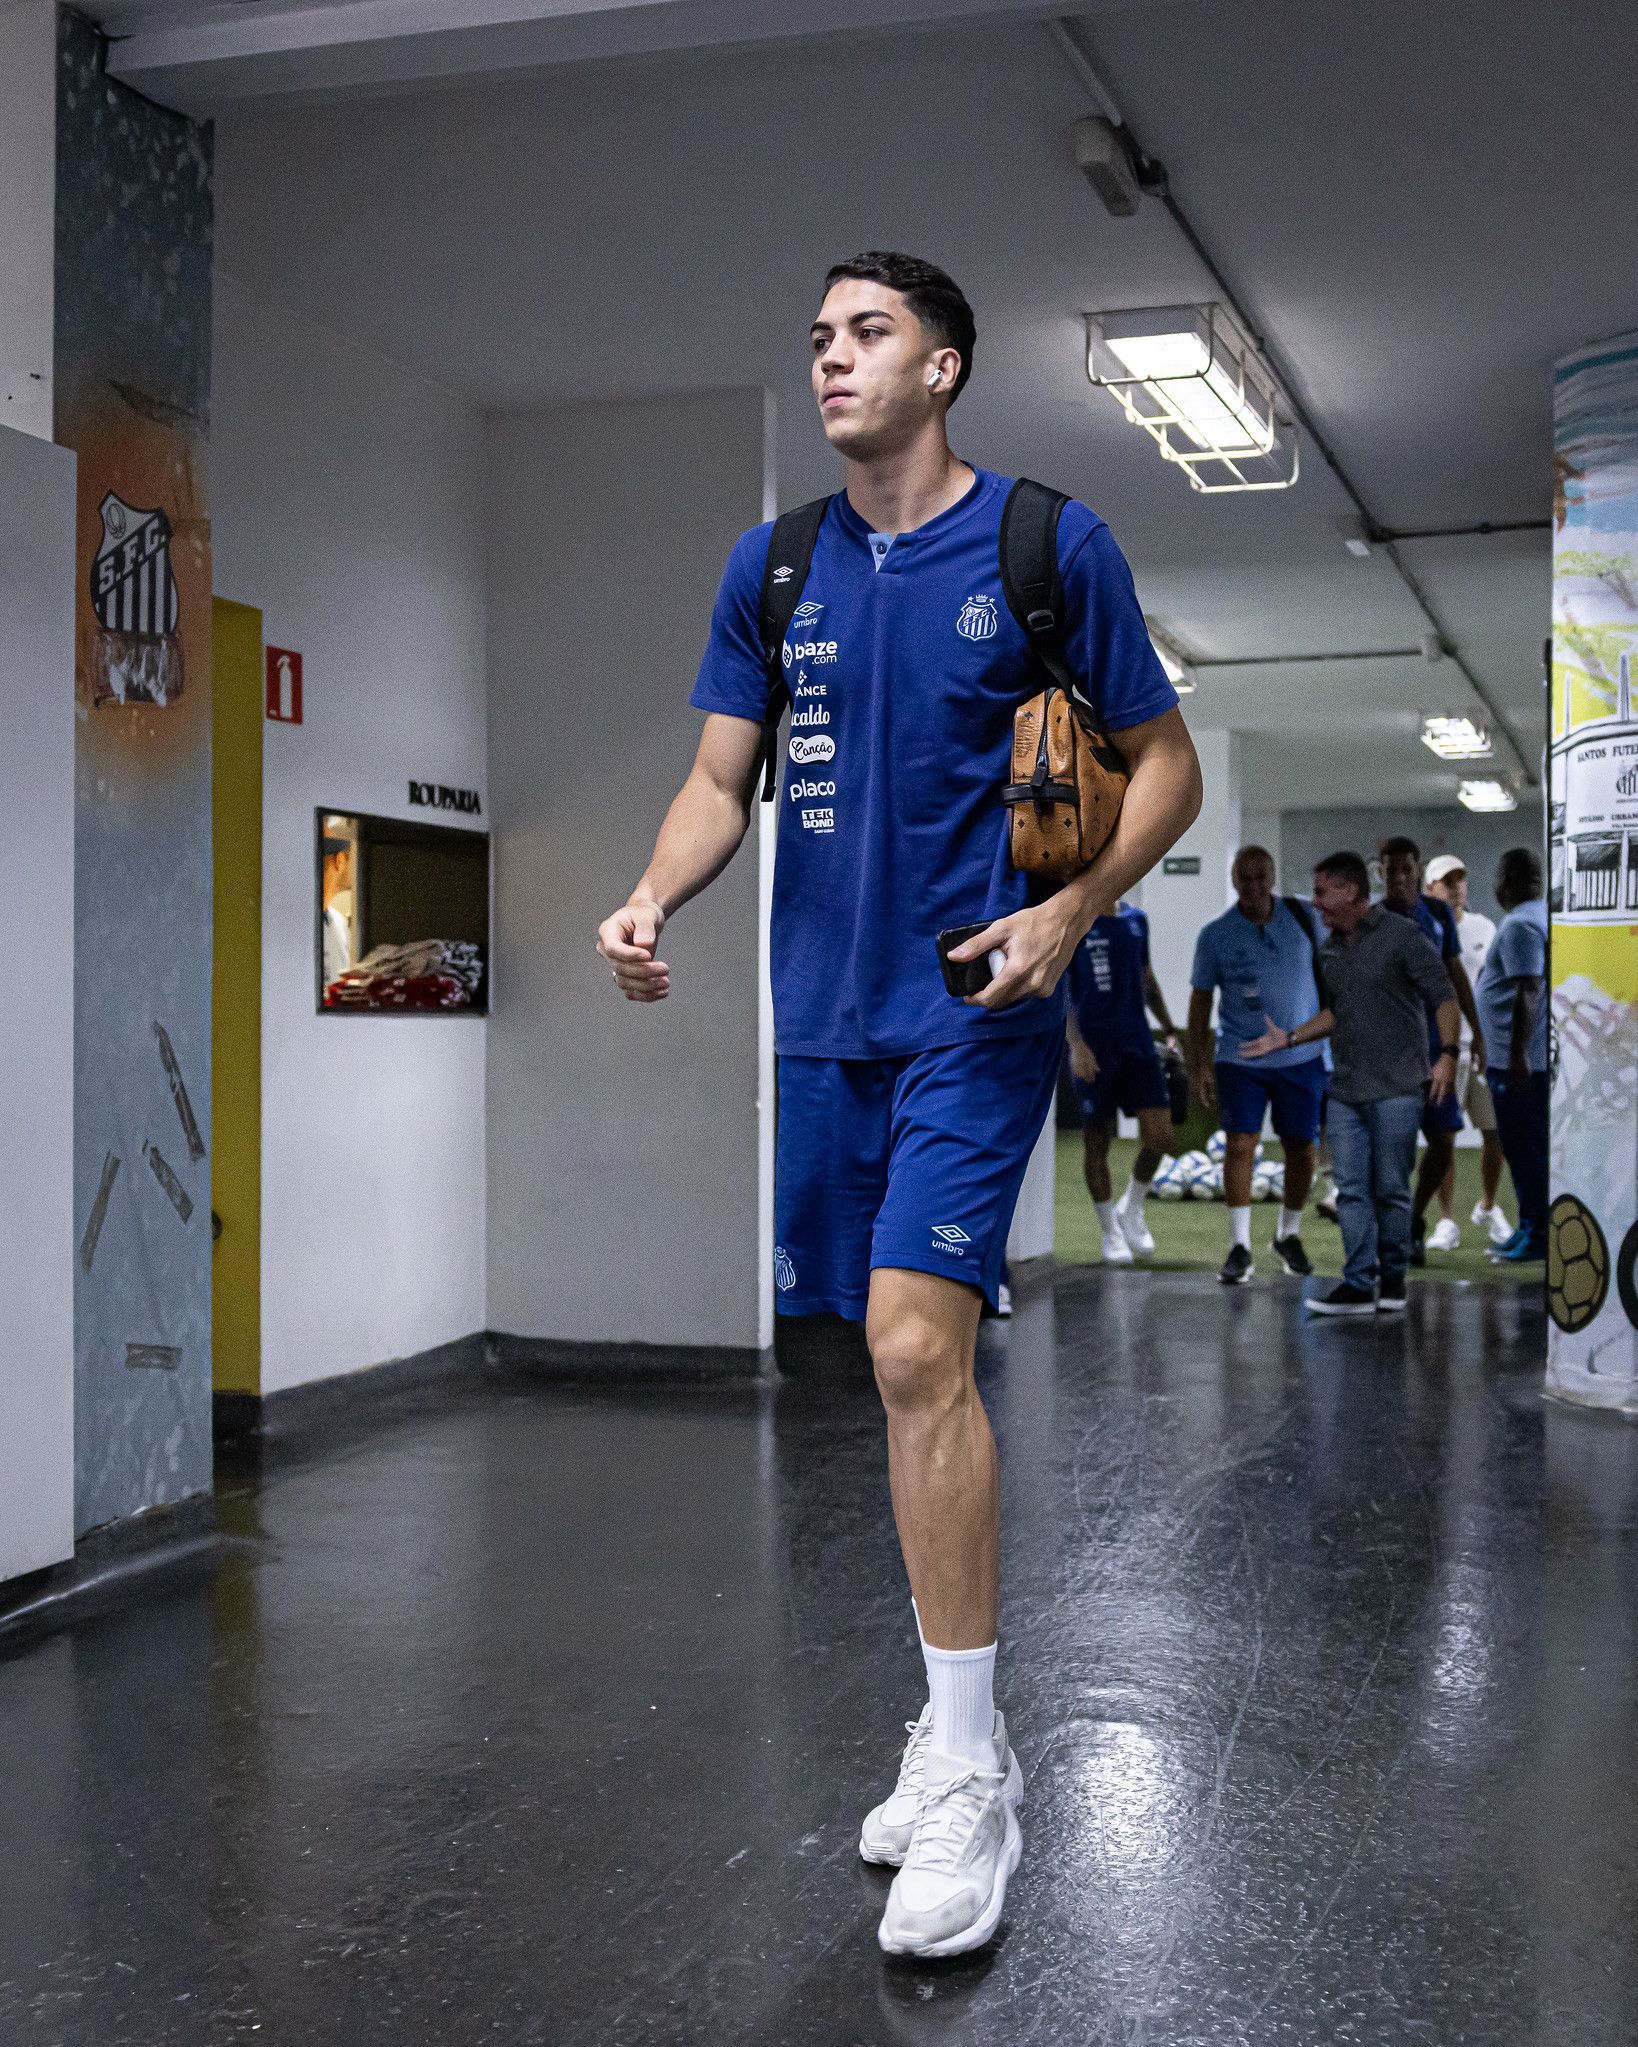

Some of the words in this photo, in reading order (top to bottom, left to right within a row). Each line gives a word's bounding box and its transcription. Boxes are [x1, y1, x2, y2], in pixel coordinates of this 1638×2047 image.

[793, 617, 818, 629] umbro
[794, 641, 838, 660] baze
[811, 655, 838, 665] .com
[795, 685, 827, 696] ANCE
[791, 740, 833, 761] Canção
[790, 778, 836, 802] placo
[408, 780, 481, 815] ROUPARIA
[802, 809, 833, 820] TEK
[803, 819, 834, 828] BOND
[932, 1240, 964, 1256] umbro
